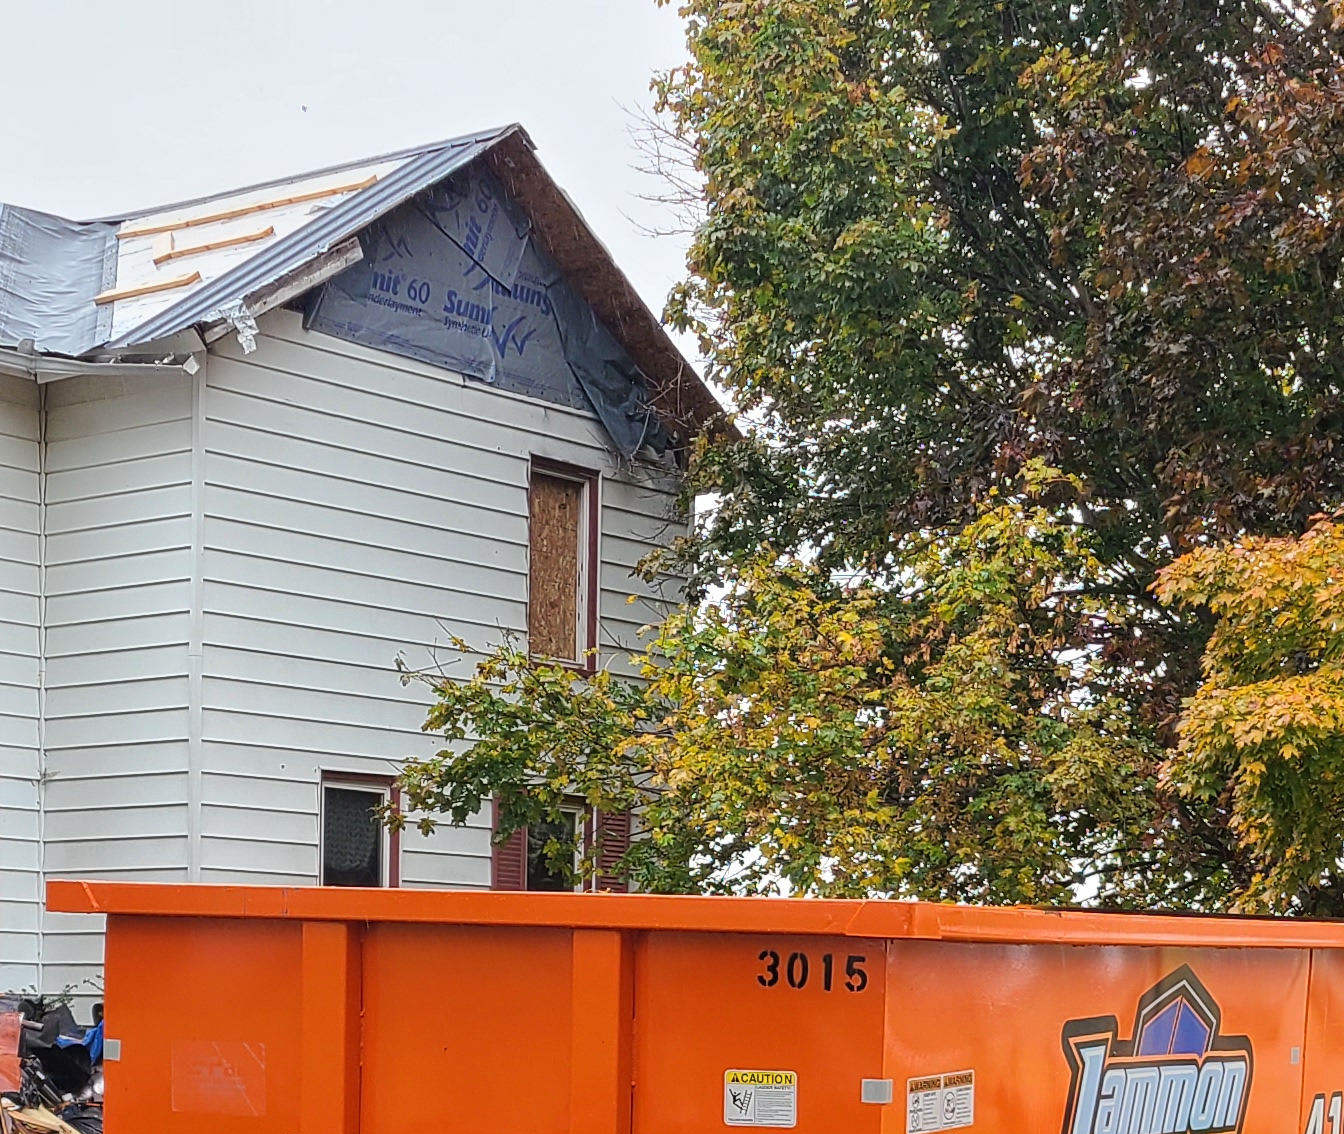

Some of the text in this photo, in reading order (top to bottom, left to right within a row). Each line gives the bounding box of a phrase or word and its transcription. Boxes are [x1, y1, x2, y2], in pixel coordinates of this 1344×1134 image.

[407, 278, 431, 305] 60
[367, 295, 422, 317] nderlayment
[756, 950, 868, 992] 3015
[740, 1073, 793, 1085] CAUTION
